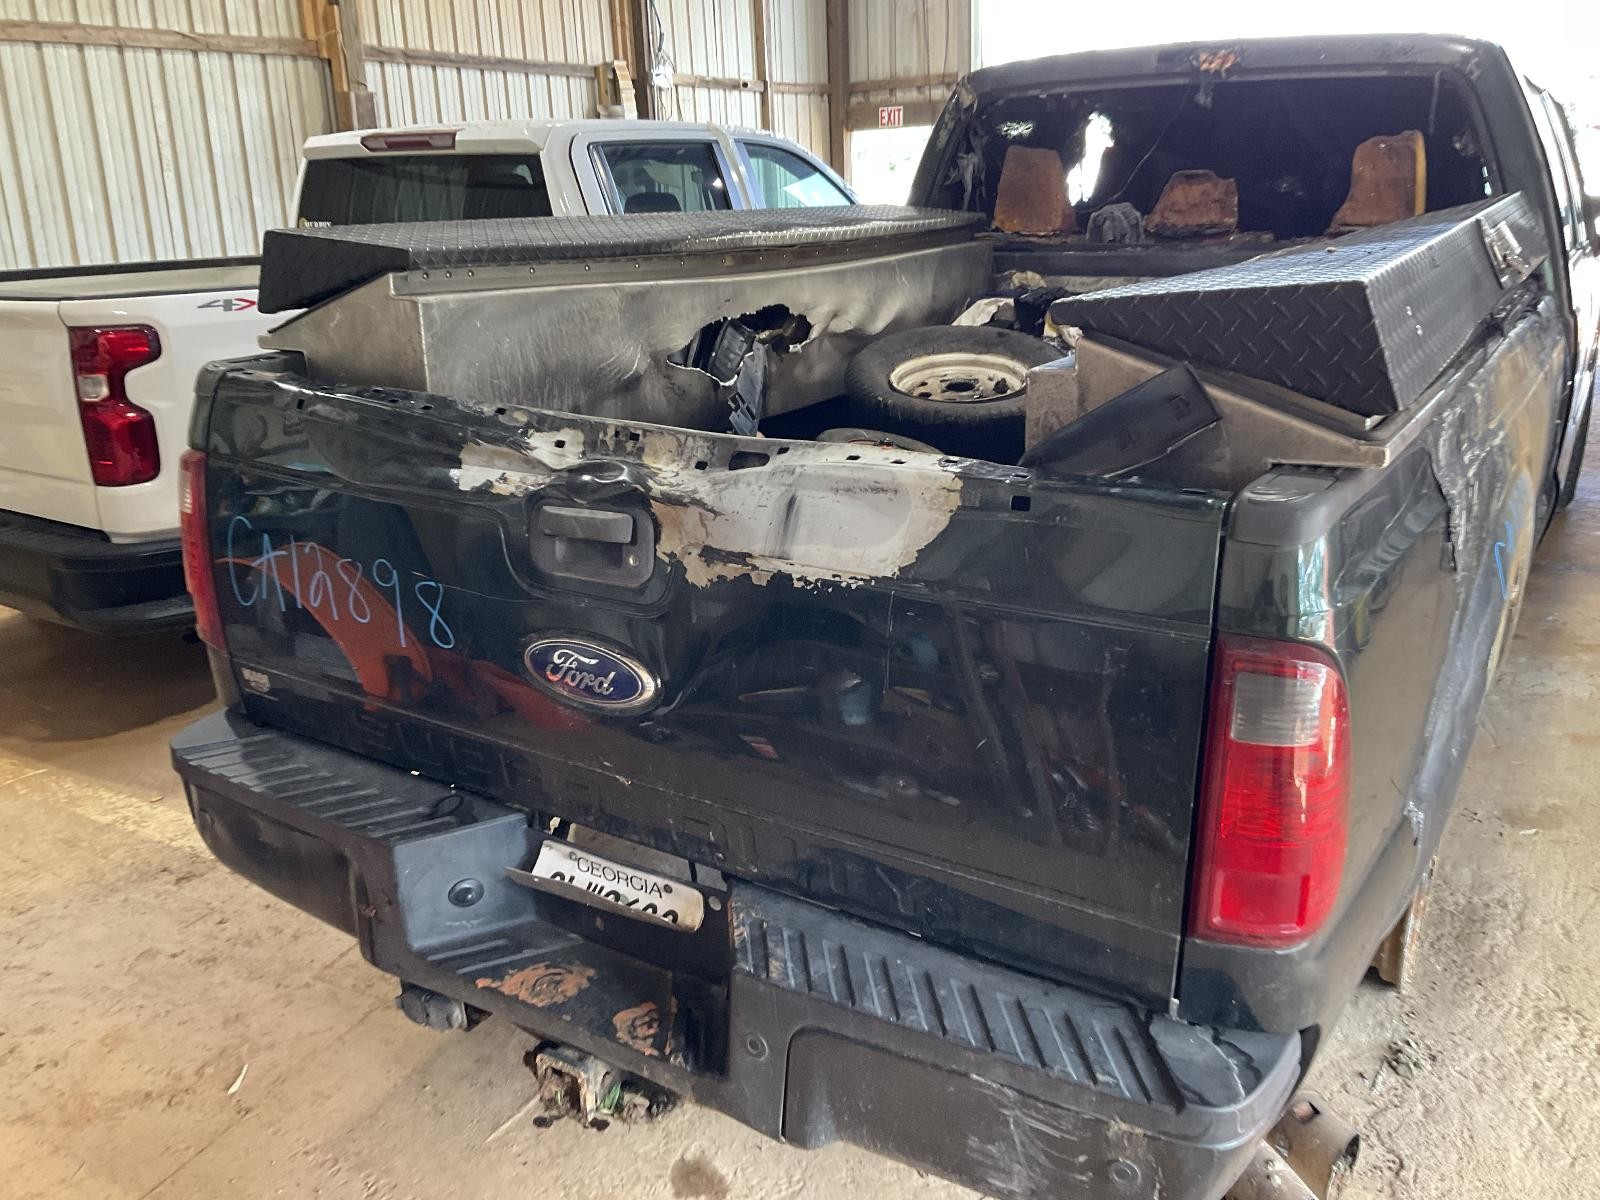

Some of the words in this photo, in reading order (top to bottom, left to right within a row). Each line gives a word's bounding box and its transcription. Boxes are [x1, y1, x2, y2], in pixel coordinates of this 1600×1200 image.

[880, 107, 902, 127] EXIT
[545, 649, 617, 696] Ford
[576, 855, 664, 899] GEORGIA
